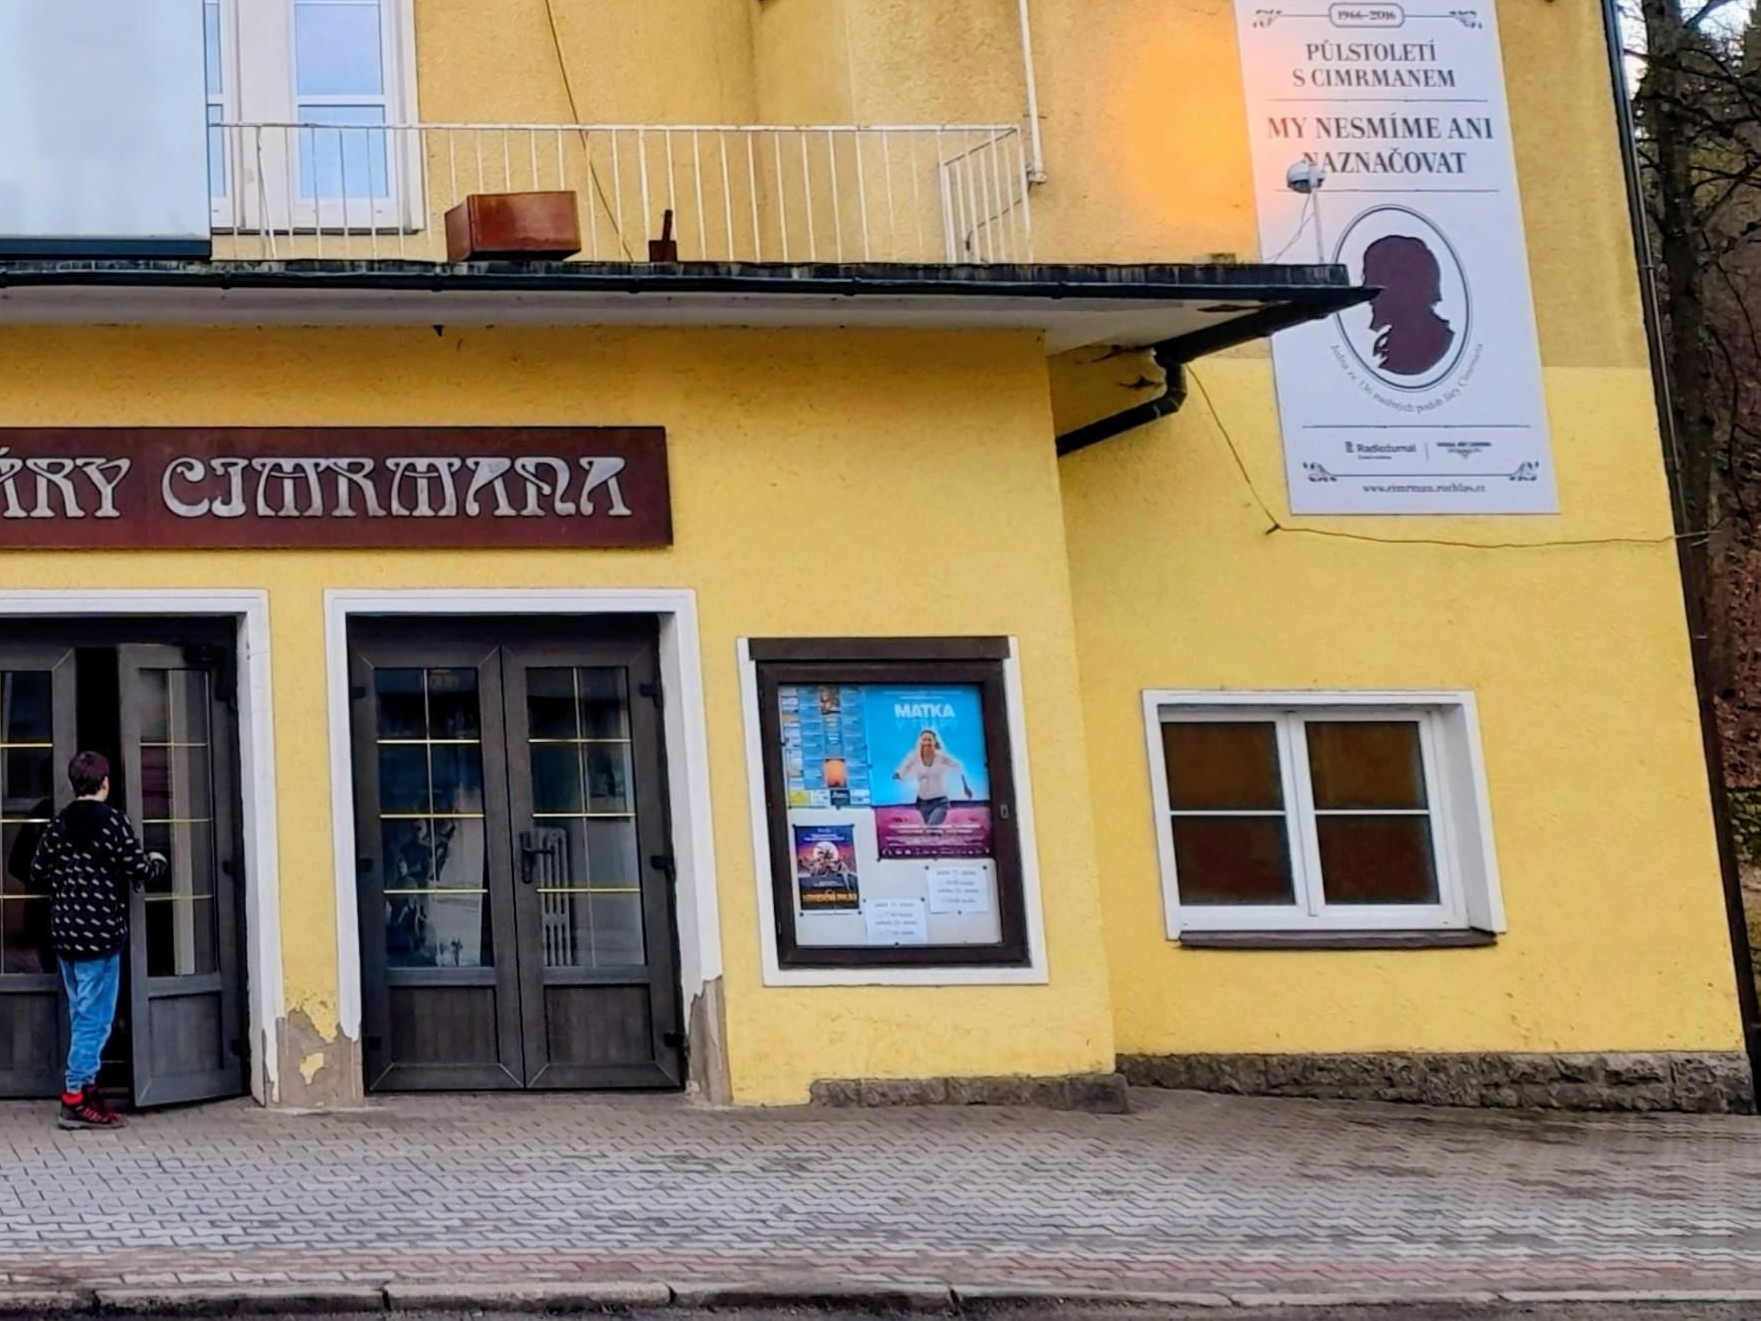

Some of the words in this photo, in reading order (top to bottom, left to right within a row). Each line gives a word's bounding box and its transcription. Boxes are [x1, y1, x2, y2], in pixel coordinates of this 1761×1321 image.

[1306, 39, 1436, 62] PŮLSTOLETÍ
[1293, 70, 1305, 87] S
[1311, 69, 1455, 87] CIMRMANEM
[1268, 117, 1310, 139] MY
[1316, 113, 1442, 139] NESMÍME
[1448, 117, 1494, 139] ANI
[161, 456, 632, 518] CIMRMANA
[894, 703, 955, 718] MATKA
